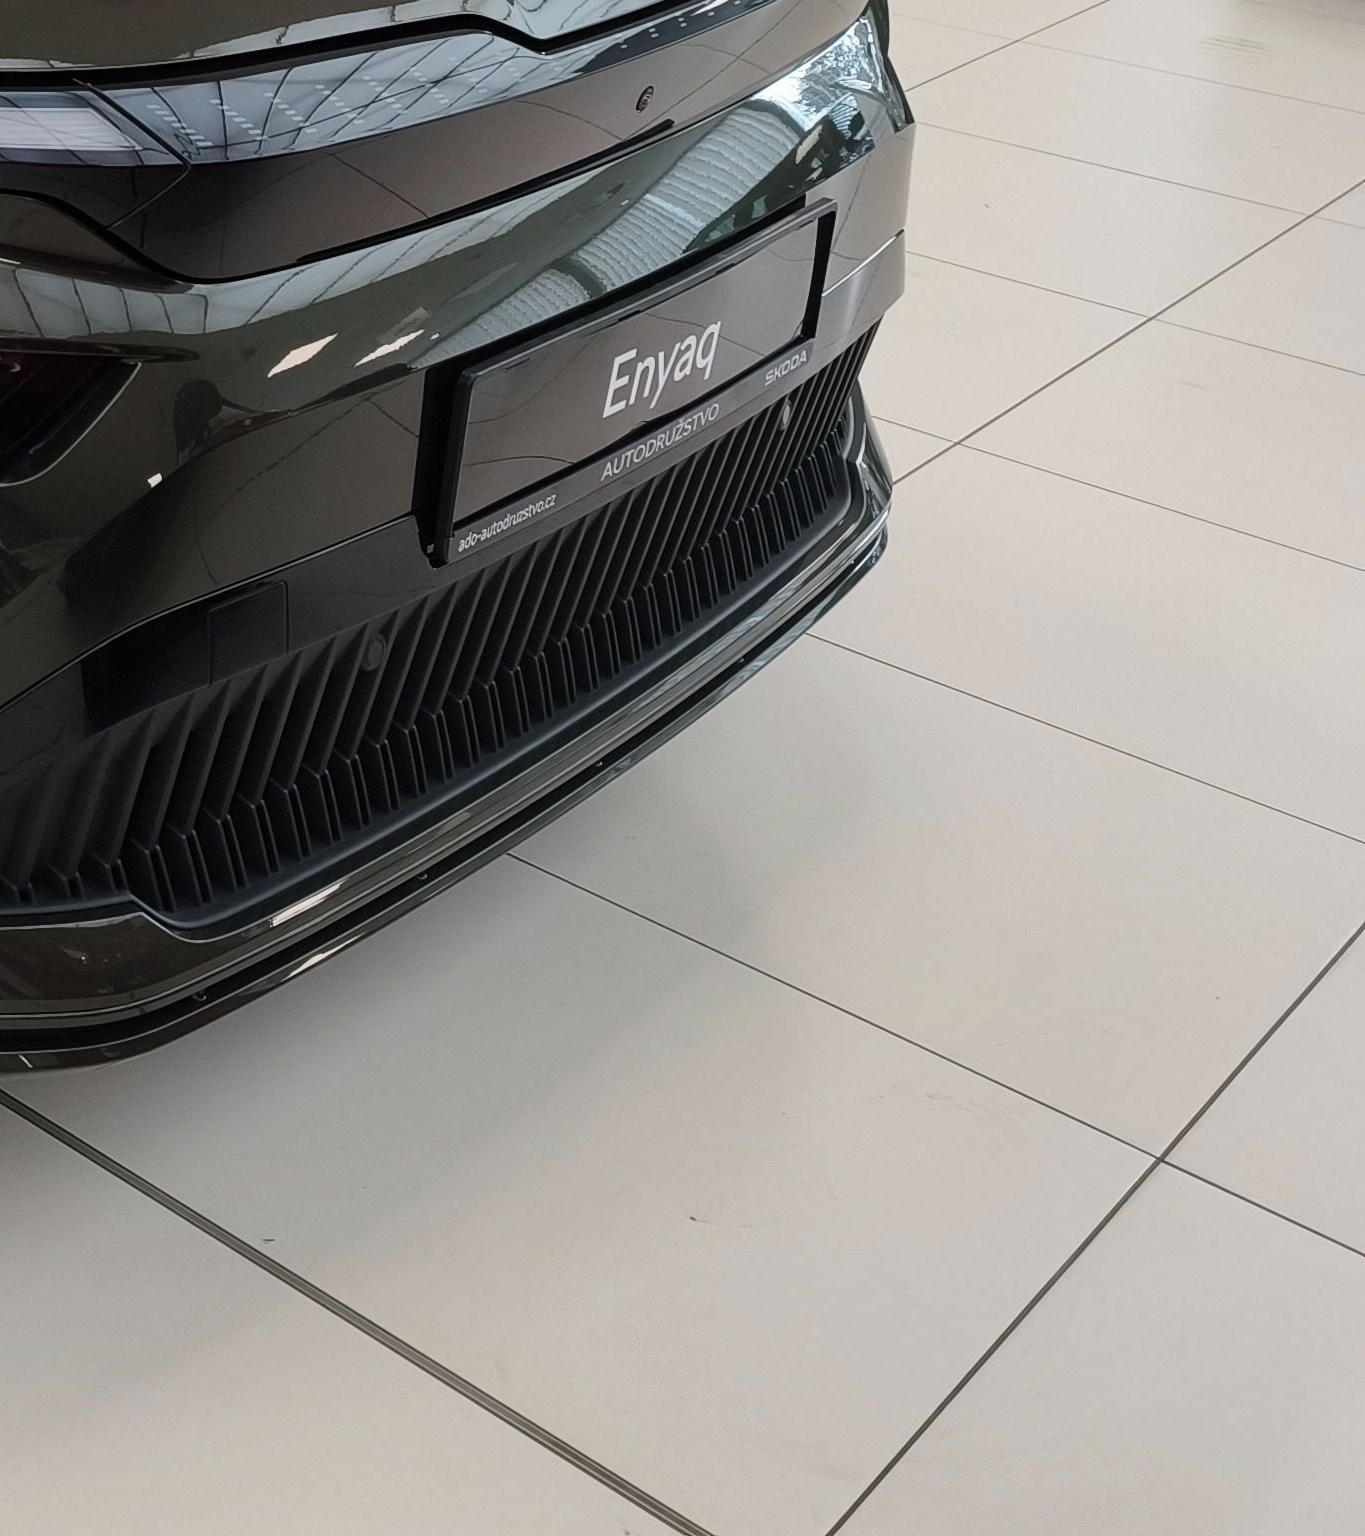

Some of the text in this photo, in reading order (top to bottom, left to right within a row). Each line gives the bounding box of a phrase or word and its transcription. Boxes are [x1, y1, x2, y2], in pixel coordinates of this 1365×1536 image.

[602, 321, 722, 419] Enyaq
[600, 403, 720, 482] AUTODRUŽSTVO
[457, 493, 557, 553] ado-autodruzstvo.cz
